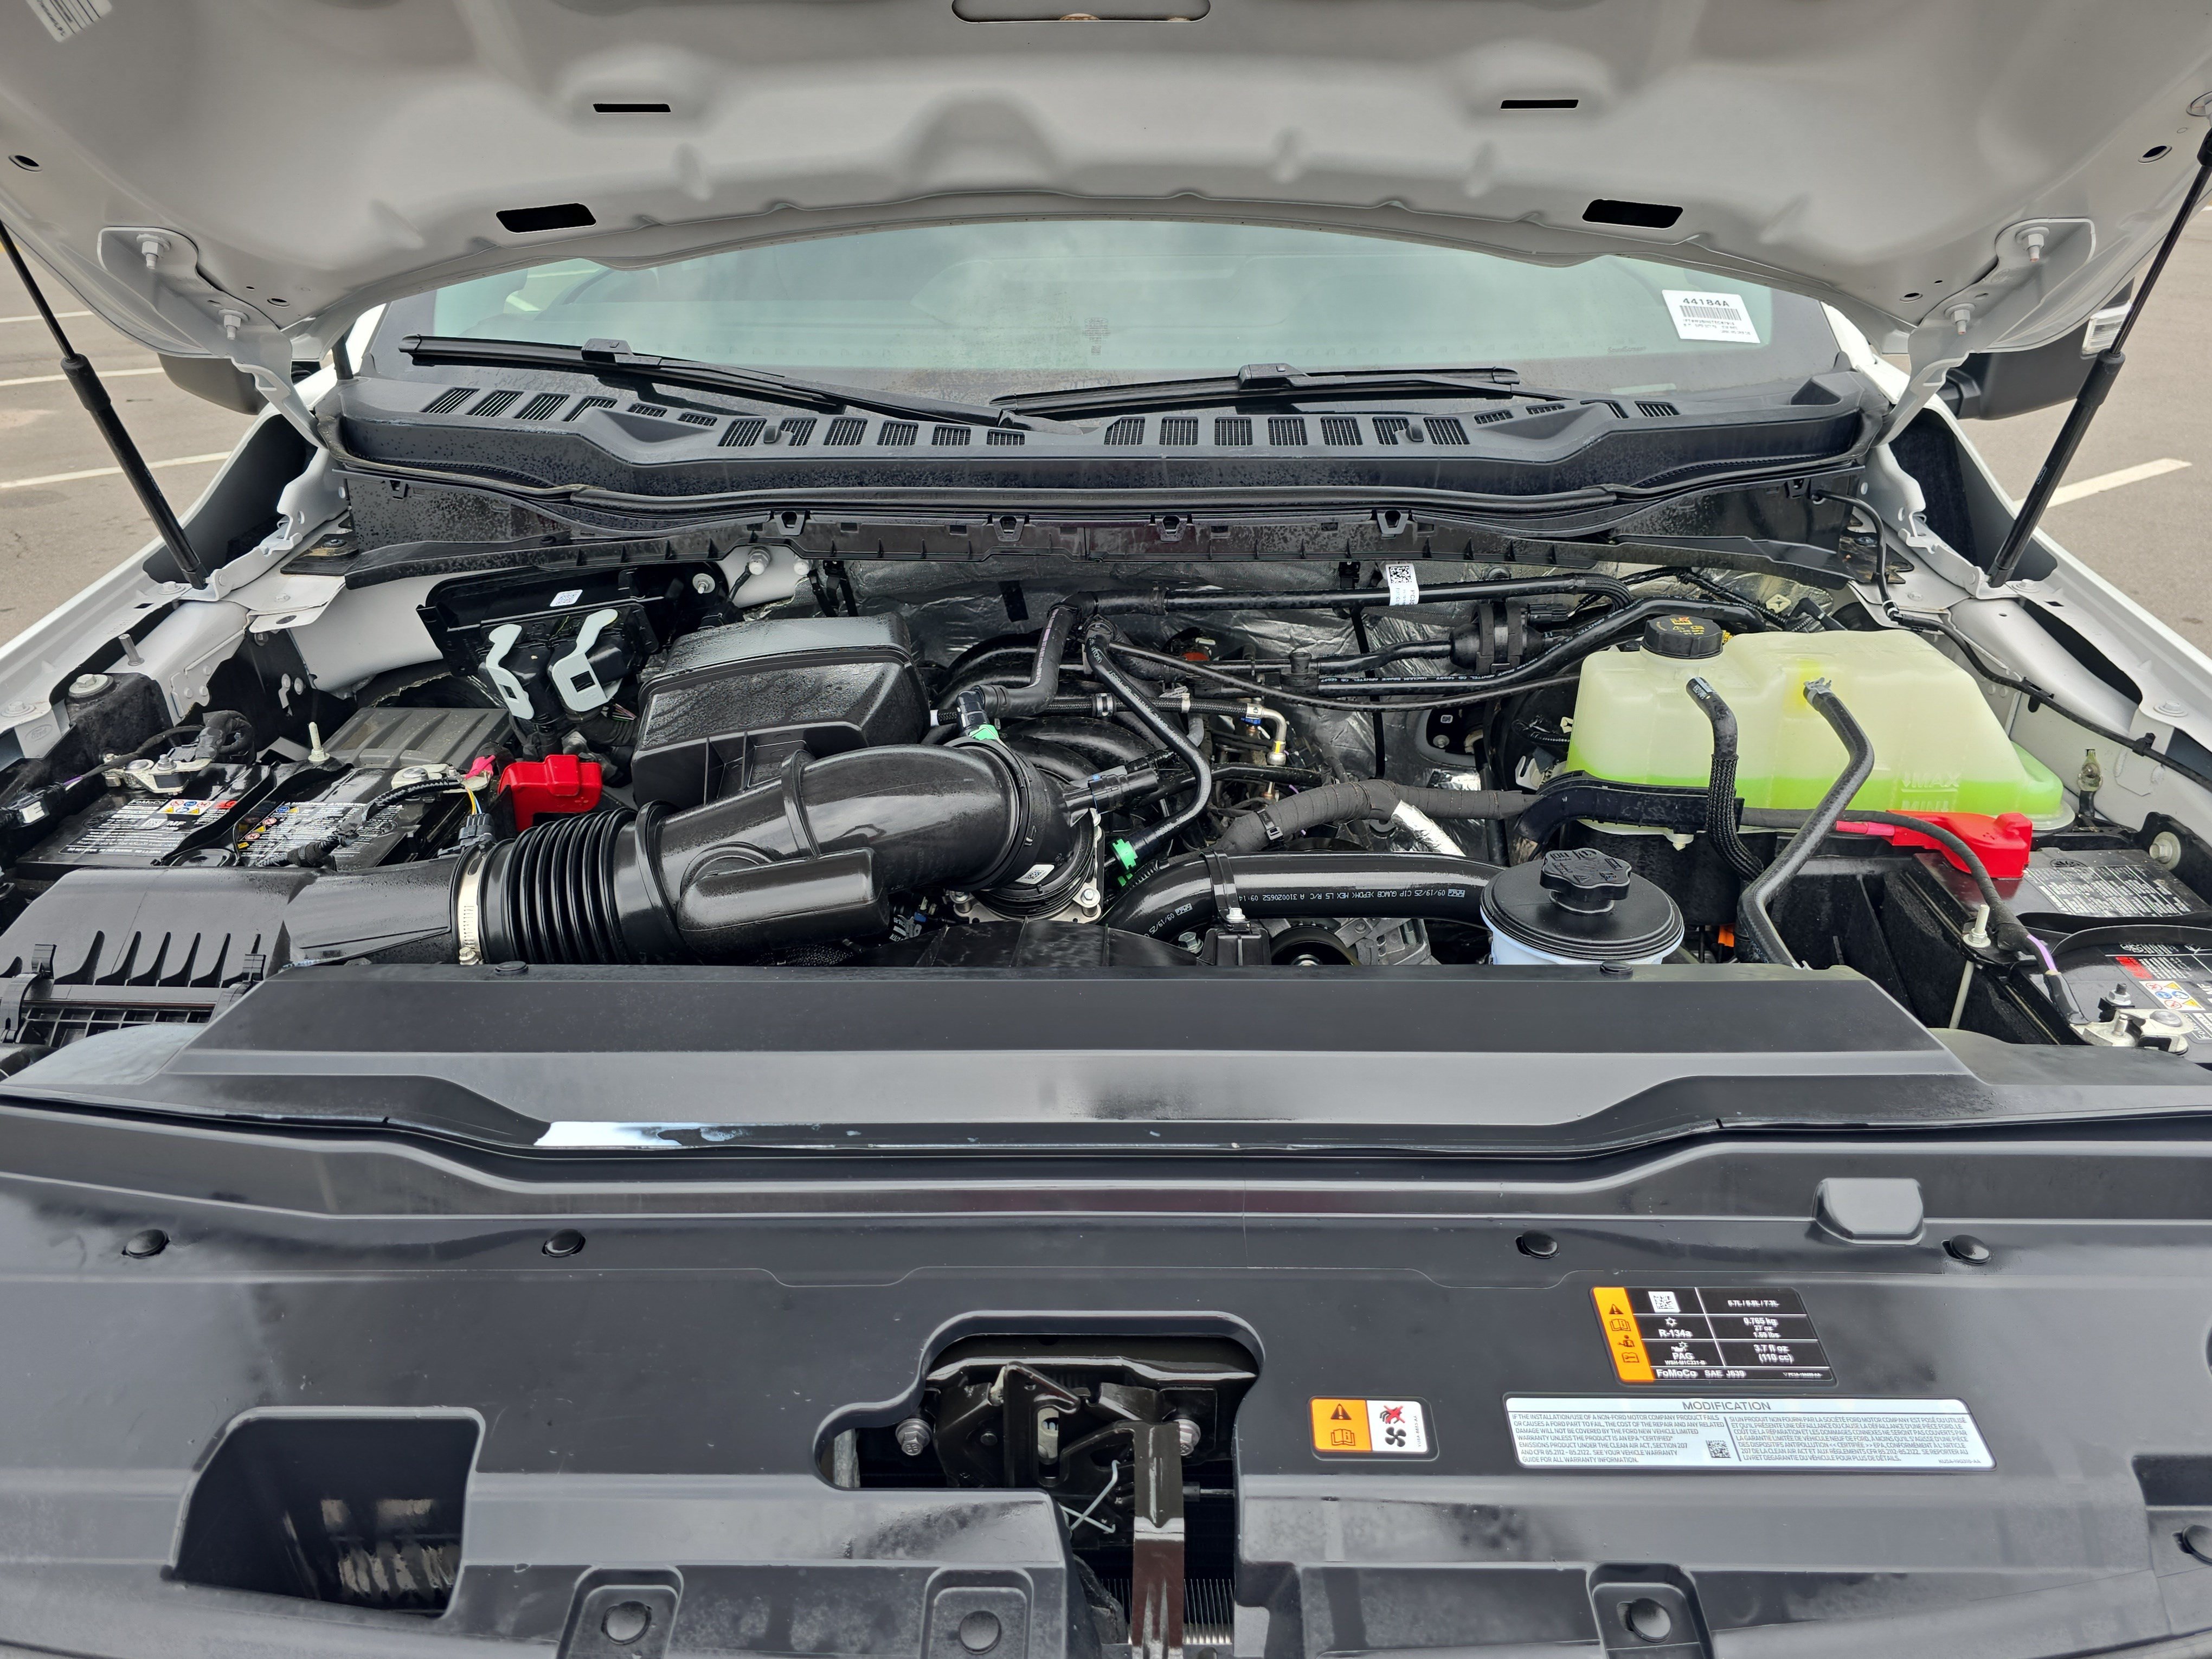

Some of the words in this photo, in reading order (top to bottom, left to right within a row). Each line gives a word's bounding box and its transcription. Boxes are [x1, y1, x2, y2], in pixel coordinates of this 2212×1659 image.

[1683, 298, 1729, 307] 44184A
[1912, 773, 1961, 788] MAX
[1149, 912, 1175, 935] 09/19/25
[1743, 1317, 1765, 1326] 0.765
[1765, 1317, 1778, 1328] kg
[1658, 1329, 1693, 1338] R-134a
[1753, 1344, 1767, 1353] 3.7
[1769, 1345, 1776, 1353] fl
[1672, 1352, 1695, 1360] PAG
[1759, 1354, 1778, 1365] (110
[1778, 1354, 1794, 1365] cc)
[1656, 1369, 1699, 1379] FoMoCo
[1705, 1370, 1724, 1378] SAE
[1726, 1369, 1747, 1378] J639
[1682, 1401, 1771, 1411] MODIFICATION
